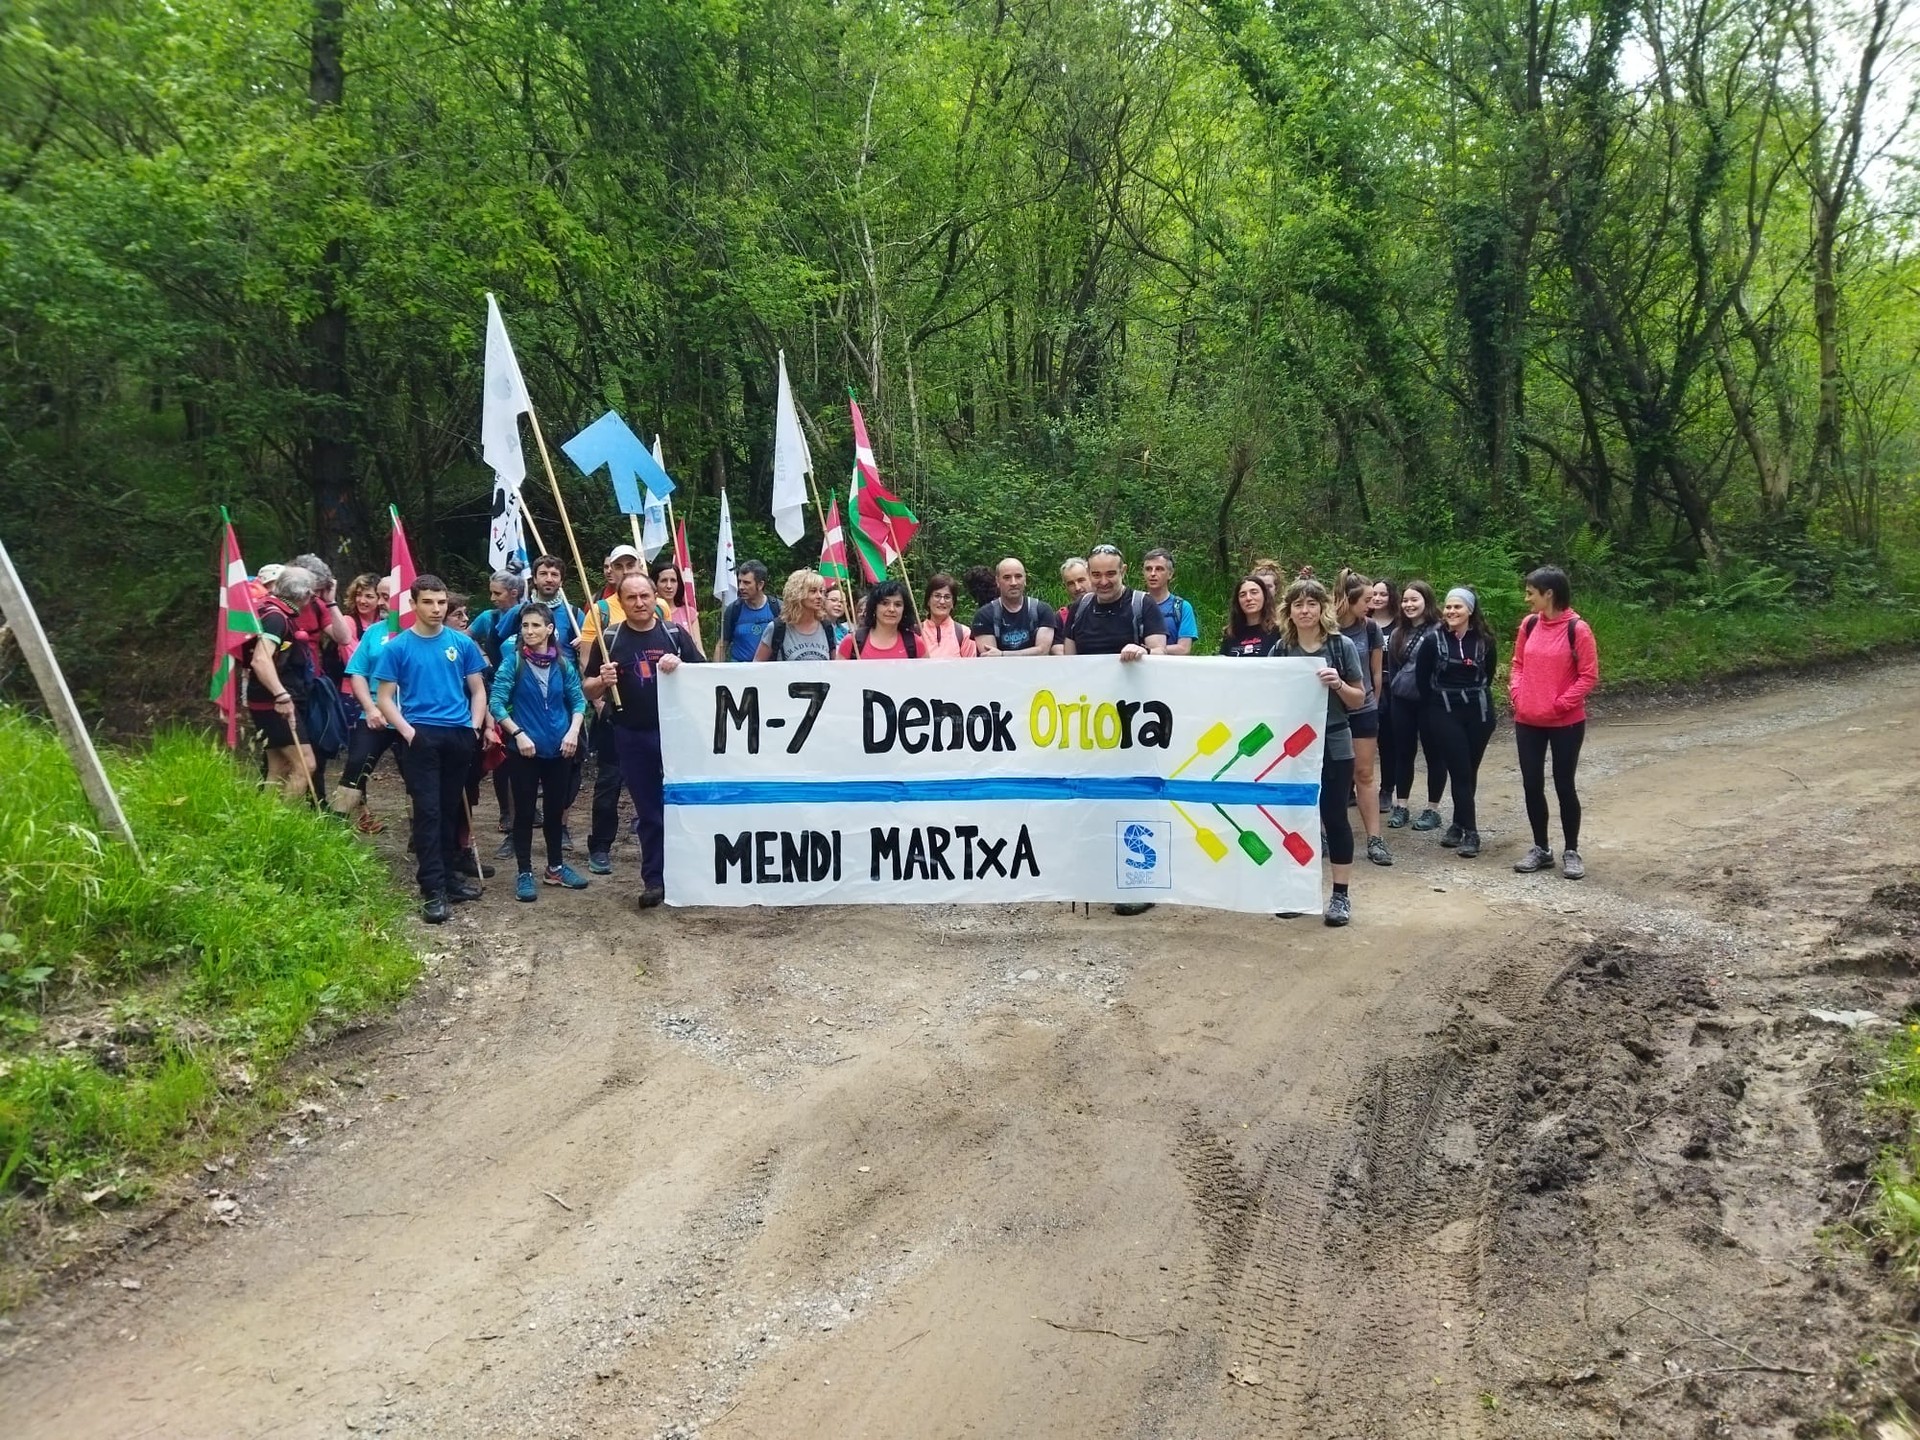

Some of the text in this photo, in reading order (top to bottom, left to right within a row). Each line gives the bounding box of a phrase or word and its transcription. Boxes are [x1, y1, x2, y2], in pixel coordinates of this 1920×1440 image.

[713, 682, 1173, 754] M-7 Denok Oriora
[714, 830, 841, 884] MENDI
[1125, 871, 1155, 886] SARE
